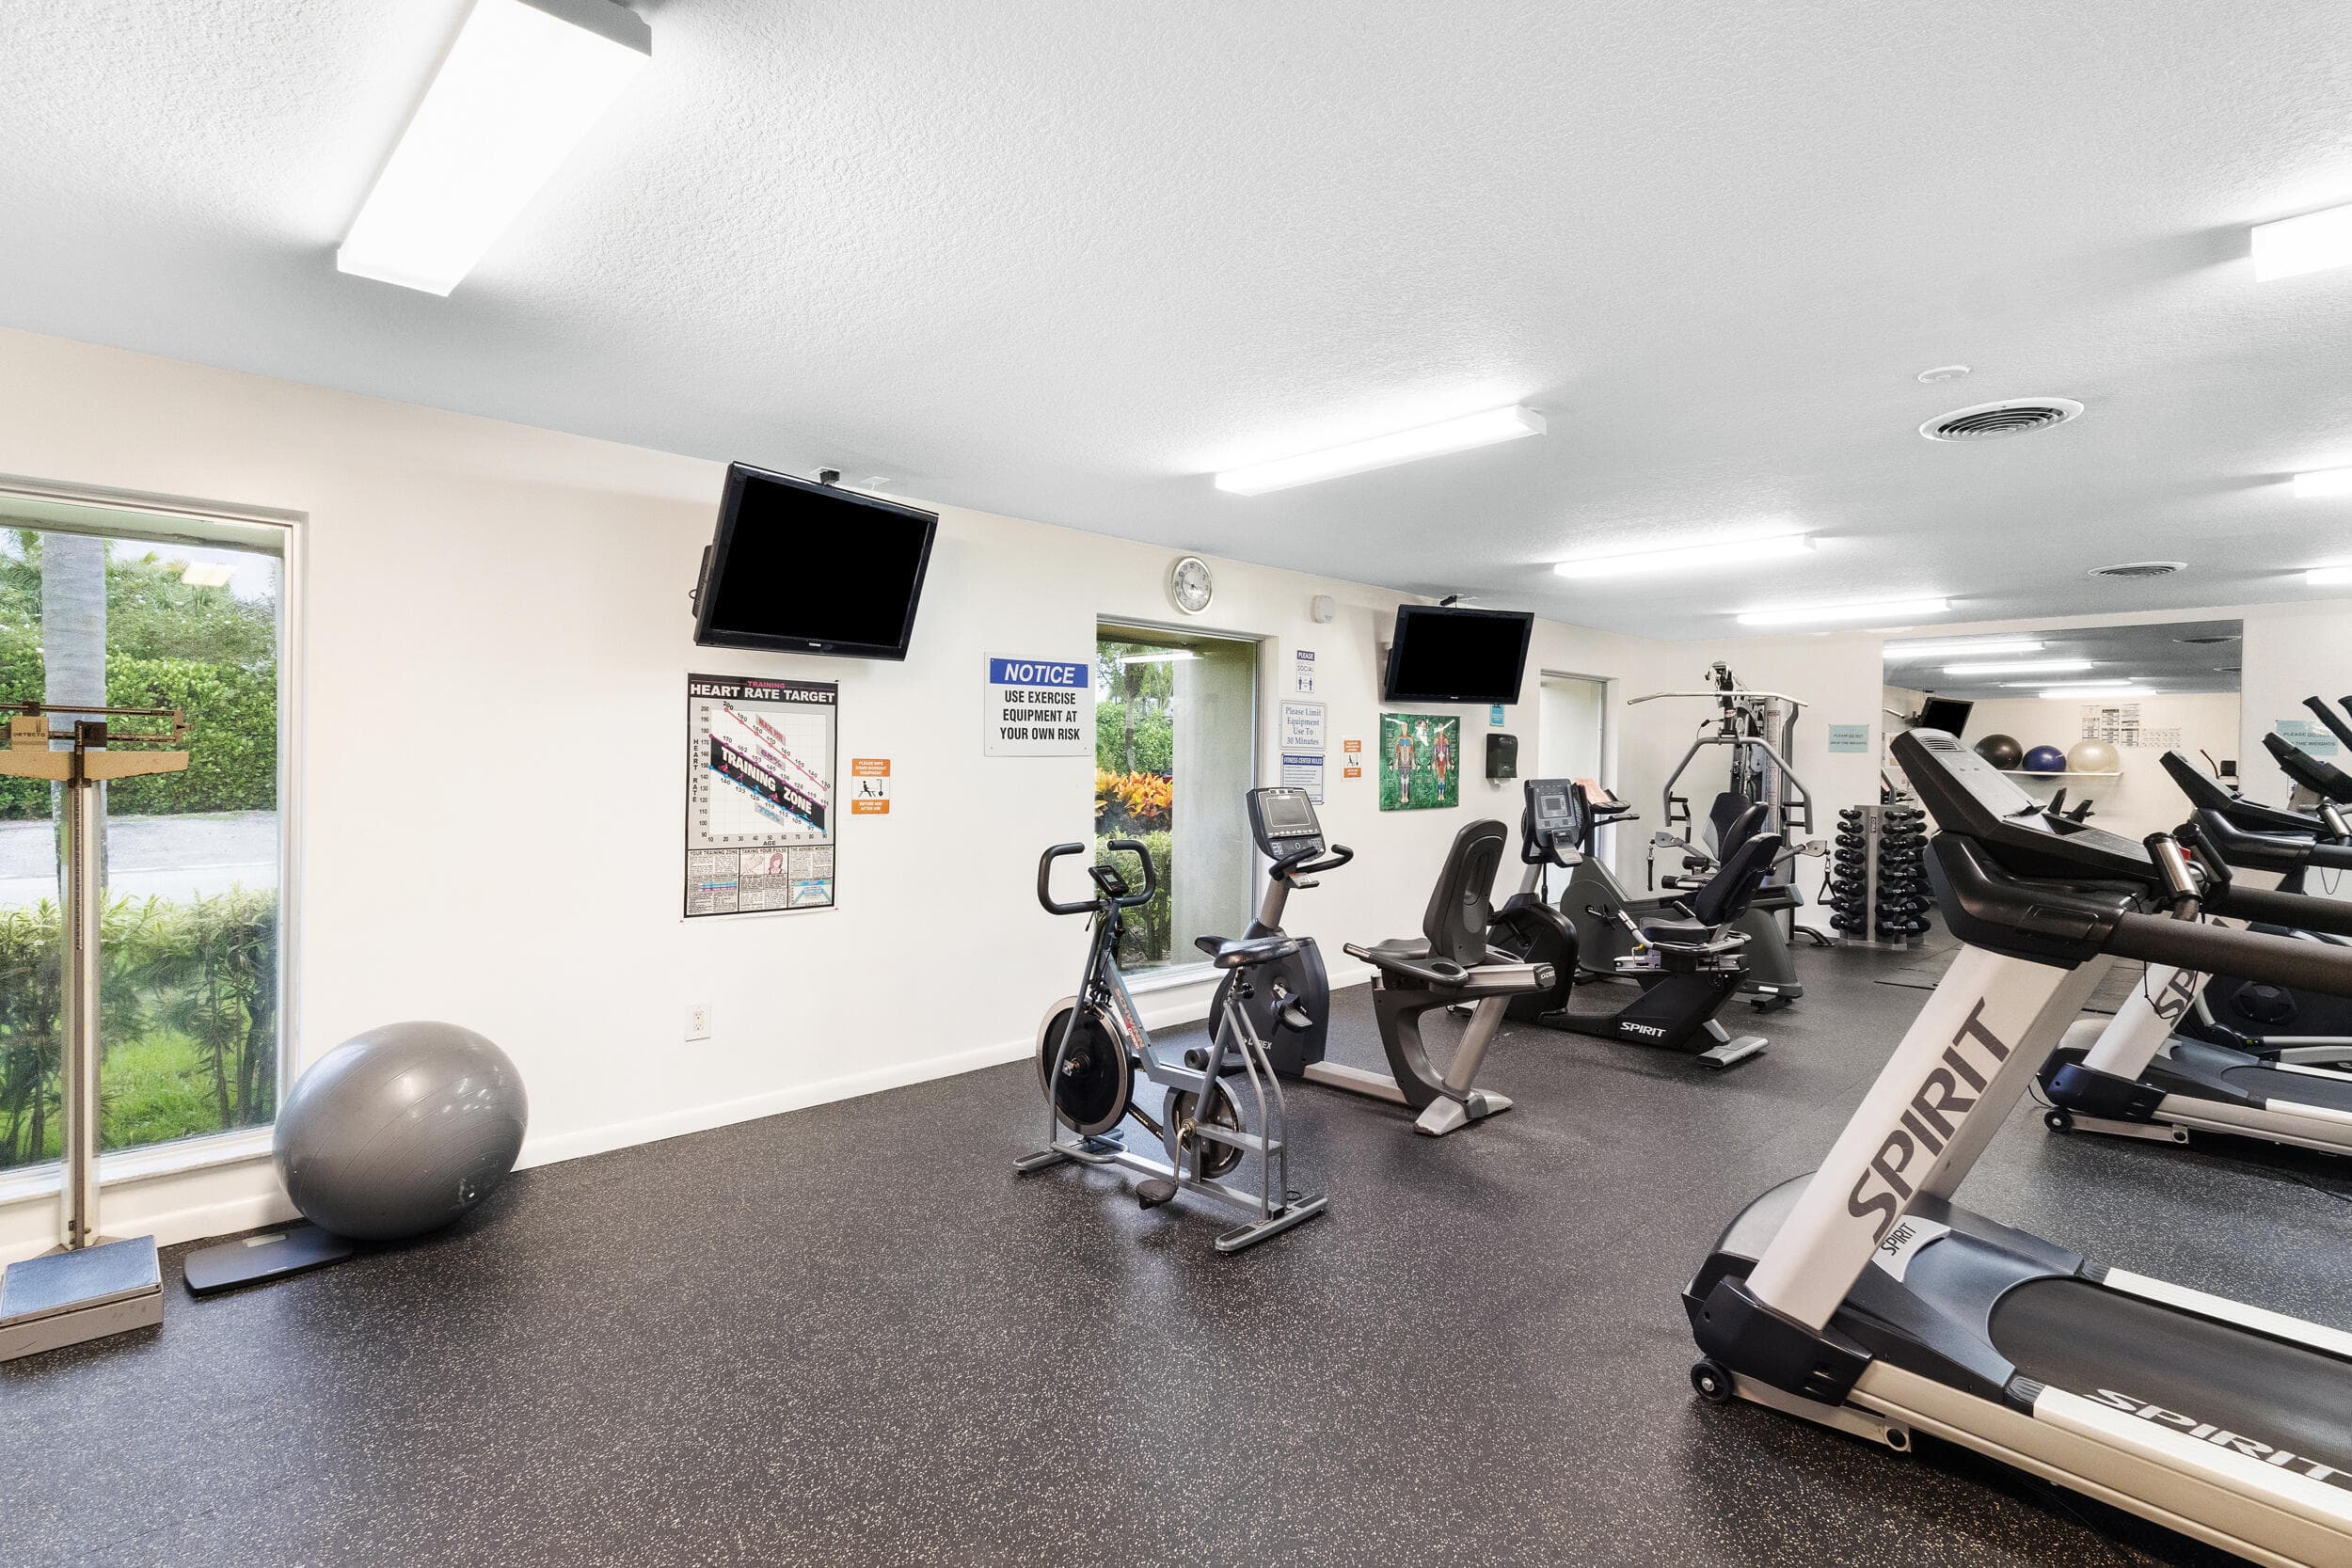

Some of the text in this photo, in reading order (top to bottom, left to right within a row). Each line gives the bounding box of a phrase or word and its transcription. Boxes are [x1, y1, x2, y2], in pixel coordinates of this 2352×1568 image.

[1004, 663, 1075, 684] NOTICE
[748, 681, 786, 689] TRAINING
[691, 684, 835, 703] HEART RATE TARGET
[1005, 690, 1076, 705] USE EXERCISE
[723, 701, 733, 710] 200
[1286, 707, 1304, 715] Please
[1003, 709, 1077, 722] EQUIPMENT AT
[1287, 717, 1319, 727] Equipment
[1000, 727, 1080, 740] YOUR OWN RISK
[721, 746, 812, 815] TRAINING ZONE
[1620, 1022, 1666, 1037] SPIRIT
[1848, 996, 2010, 1245] SPIRIT
[1880, 1222, 1916, 1256] SPIRIT
[2082, 1388, 2352, 1481] SPIRIT
